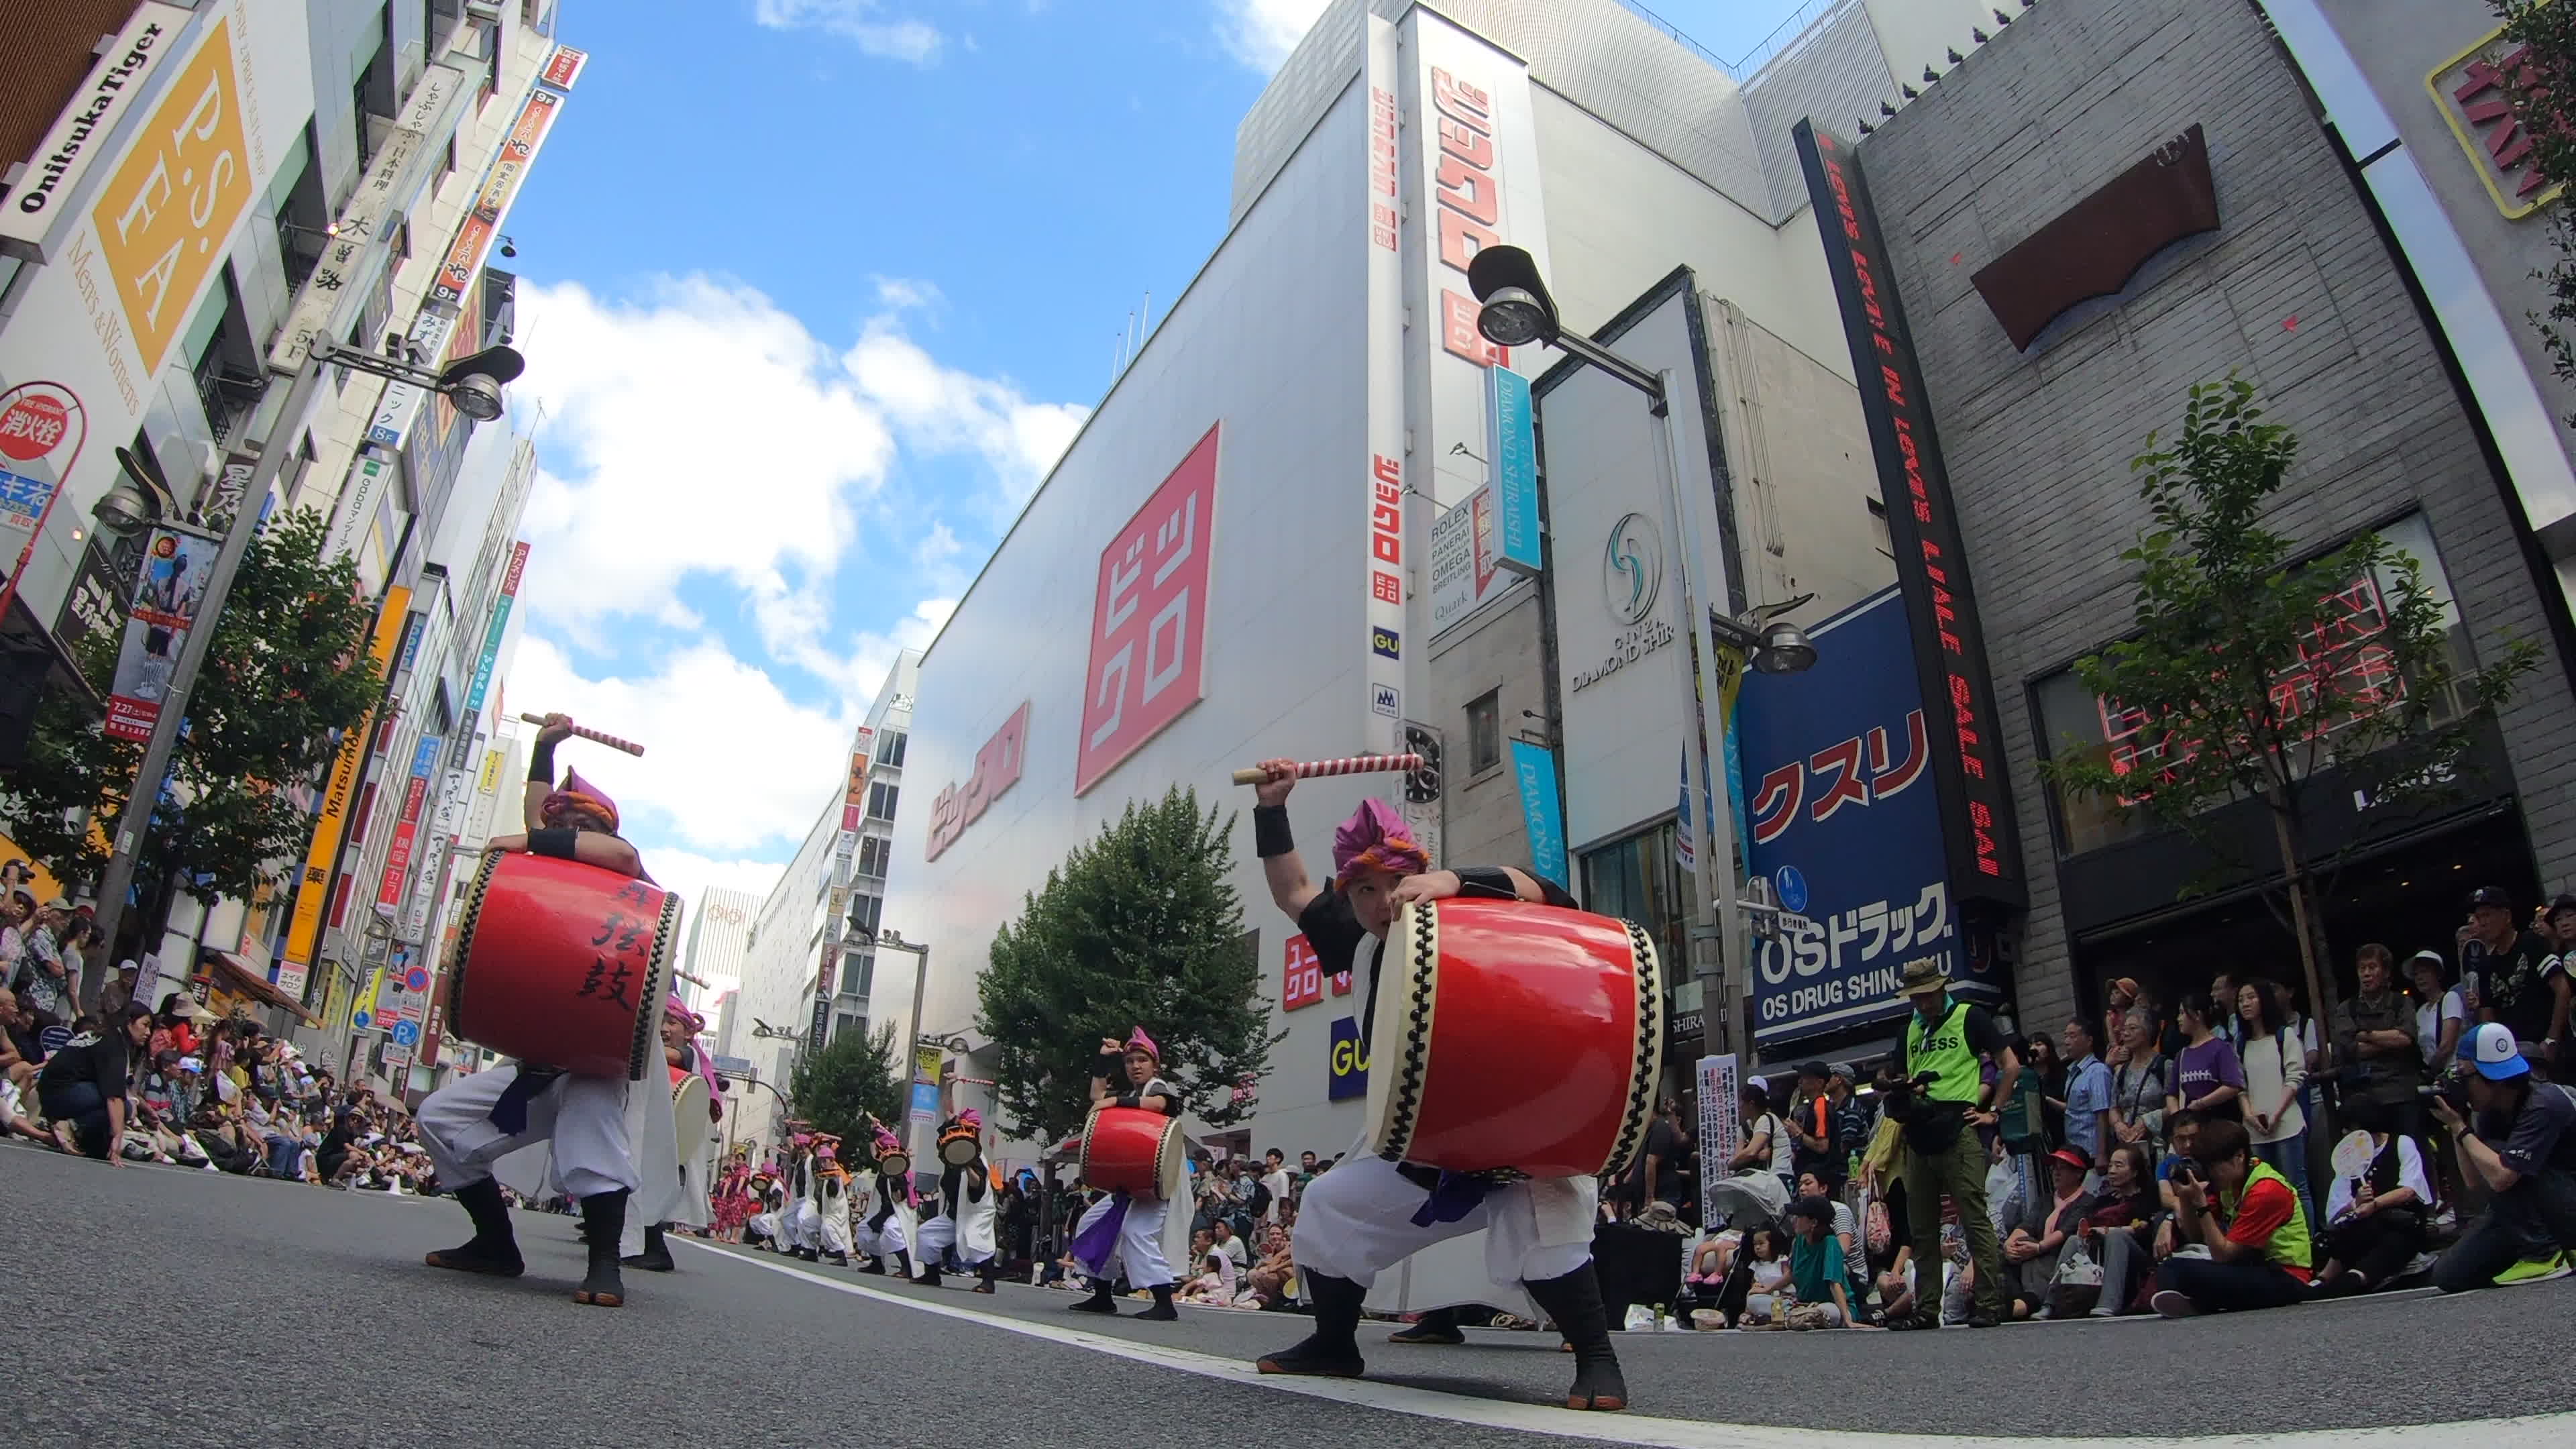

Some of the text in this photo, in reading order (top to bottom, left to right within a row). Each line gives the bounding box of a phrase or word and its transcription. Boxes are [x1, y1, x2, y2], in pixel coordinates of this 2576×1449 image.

[536, 93, 553, 105] 9F
[436, 286, 458, 300] 9F
[0, 408, 63, 447] 消火栓
[375, 428, 392, 441] 8F
[1373, 453, 1400, 565] ビックロ
[1432, 504, 1470, 542] ROLEX
[1432, 525, 1470, 561] PANERAI
[1432, 548, 1470, 582] OMEGA
[1432, 561, 1471, 594] BREITLING
[1374, 634, 1399, 652] GU
[1948, 673, 1986, 780] SALE
[926, 699, 1030, 863] ビックロ
[1753, 708, 1929, 846] クスリ
[1760, 880, 1952, 985] OSドラッグ
[1762, 994, 1788, 1020] OS
[1792, 980, 1843, 1014] DRUG
